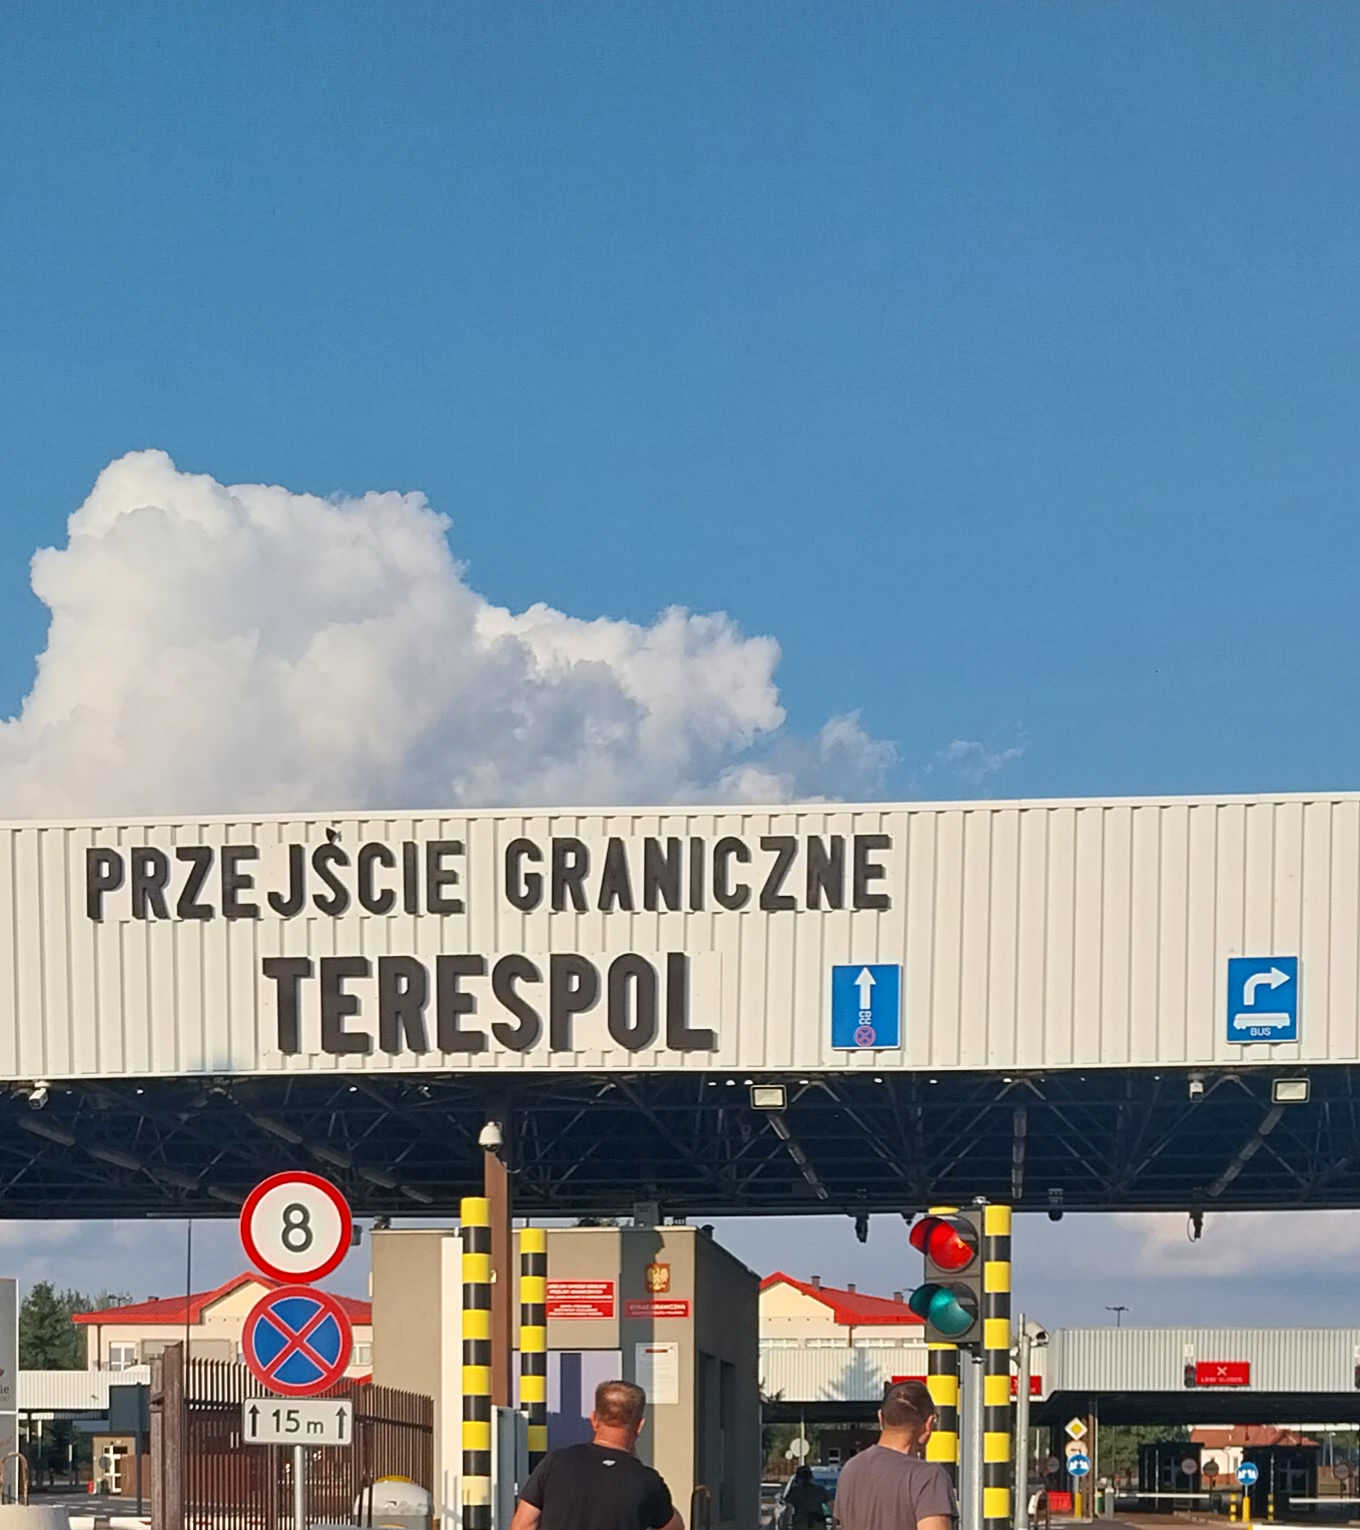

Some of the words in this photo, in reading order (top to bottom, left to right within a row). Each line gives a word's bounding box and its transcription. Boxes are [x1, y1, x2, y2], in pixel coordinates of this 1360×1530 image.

[86, 826, 466, 920] PRZEJŚCIE
[505, 833, 892, 913] GRANICZNE
[262, 952, 720, 1055] TERESPOL
[1250, 1027, 1272, 1037] BUS
[281, 1203, 313, 1253] 8
[271, 1409, 301, 1434] 15
[306, 1419, 324, 1434] m
